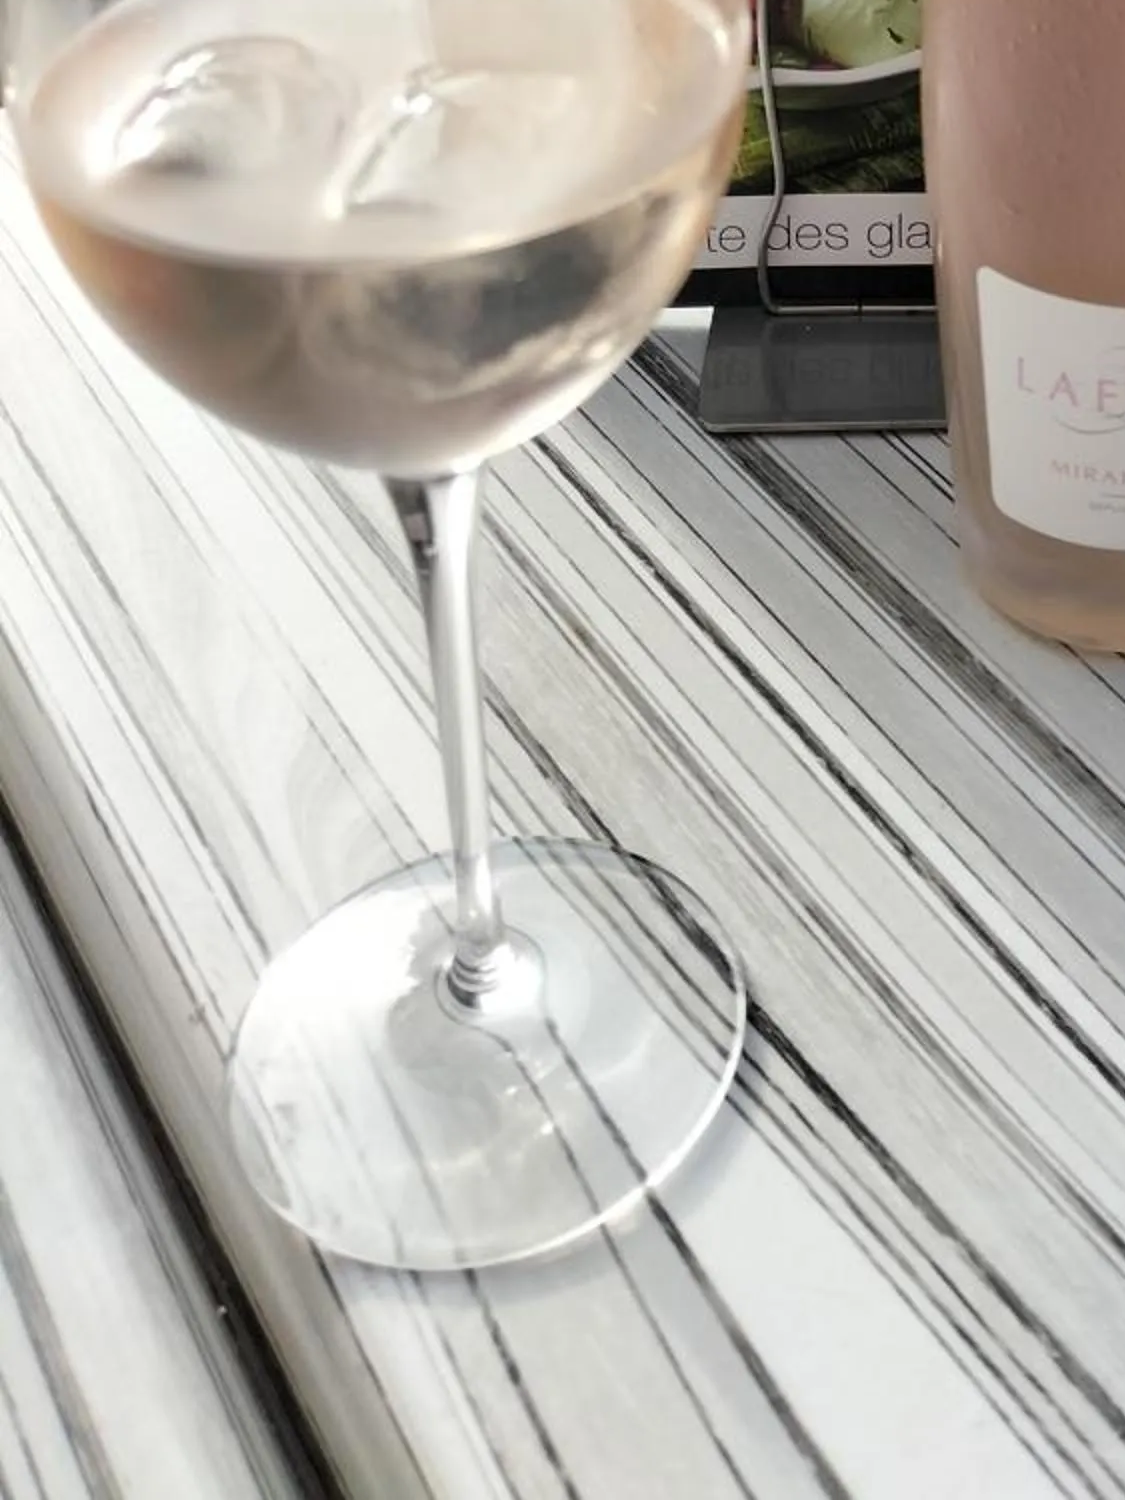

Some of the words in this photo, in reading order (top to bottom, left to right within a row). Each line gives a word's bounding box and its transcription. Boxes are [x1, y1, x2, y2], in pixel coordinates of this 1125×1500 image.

[705, 223, 746, 253] te
[766, 214, 849, 251] des
[866, 212, 933, 259] gla
